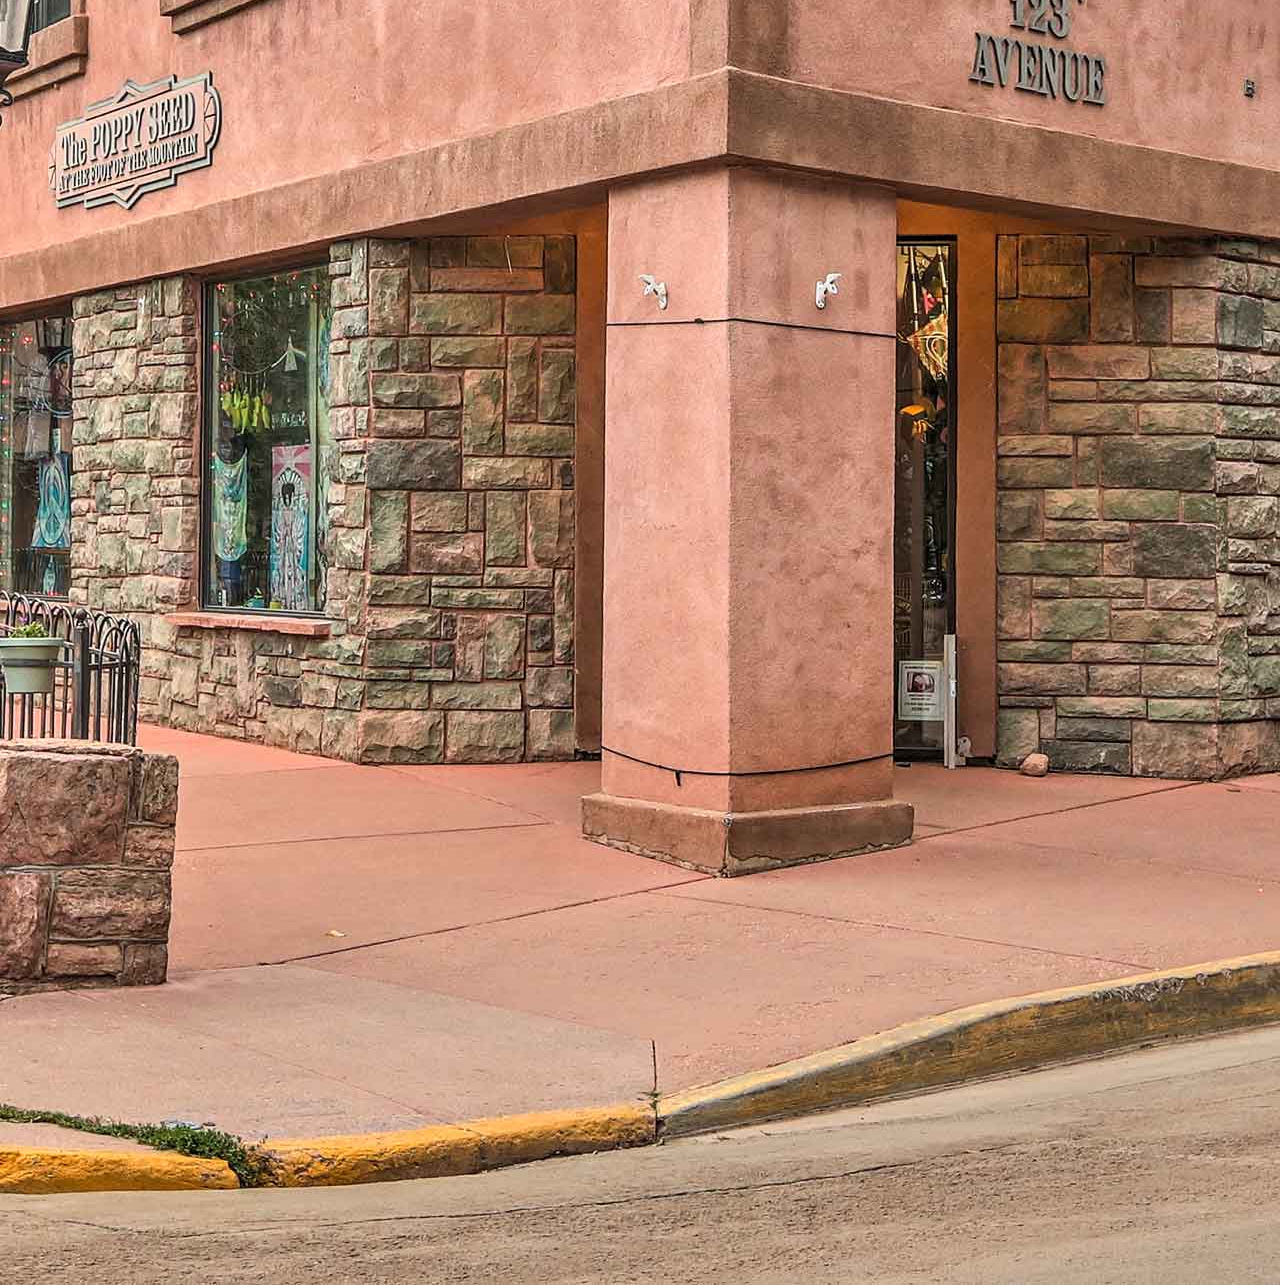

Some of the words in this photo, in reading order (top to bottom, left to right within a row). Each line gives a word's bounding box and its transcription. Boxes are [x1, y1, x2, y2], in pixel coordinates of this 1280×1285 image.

[969, 32, 1106, 105] AVENUE
[59, 173, 71, 194] AT
[70, 166, 90, 190] THE
[90, 160, 113, 186] FOOT
[114, 158, 126, 178] OF
[126, 151, 148, 174] THE
[149, 134, 198, 167] MOUNTAIN
[61, 132, 87, 171] The
[90, 107, 145, 163] POPPY
[148, 92, 195, 144] SEED
